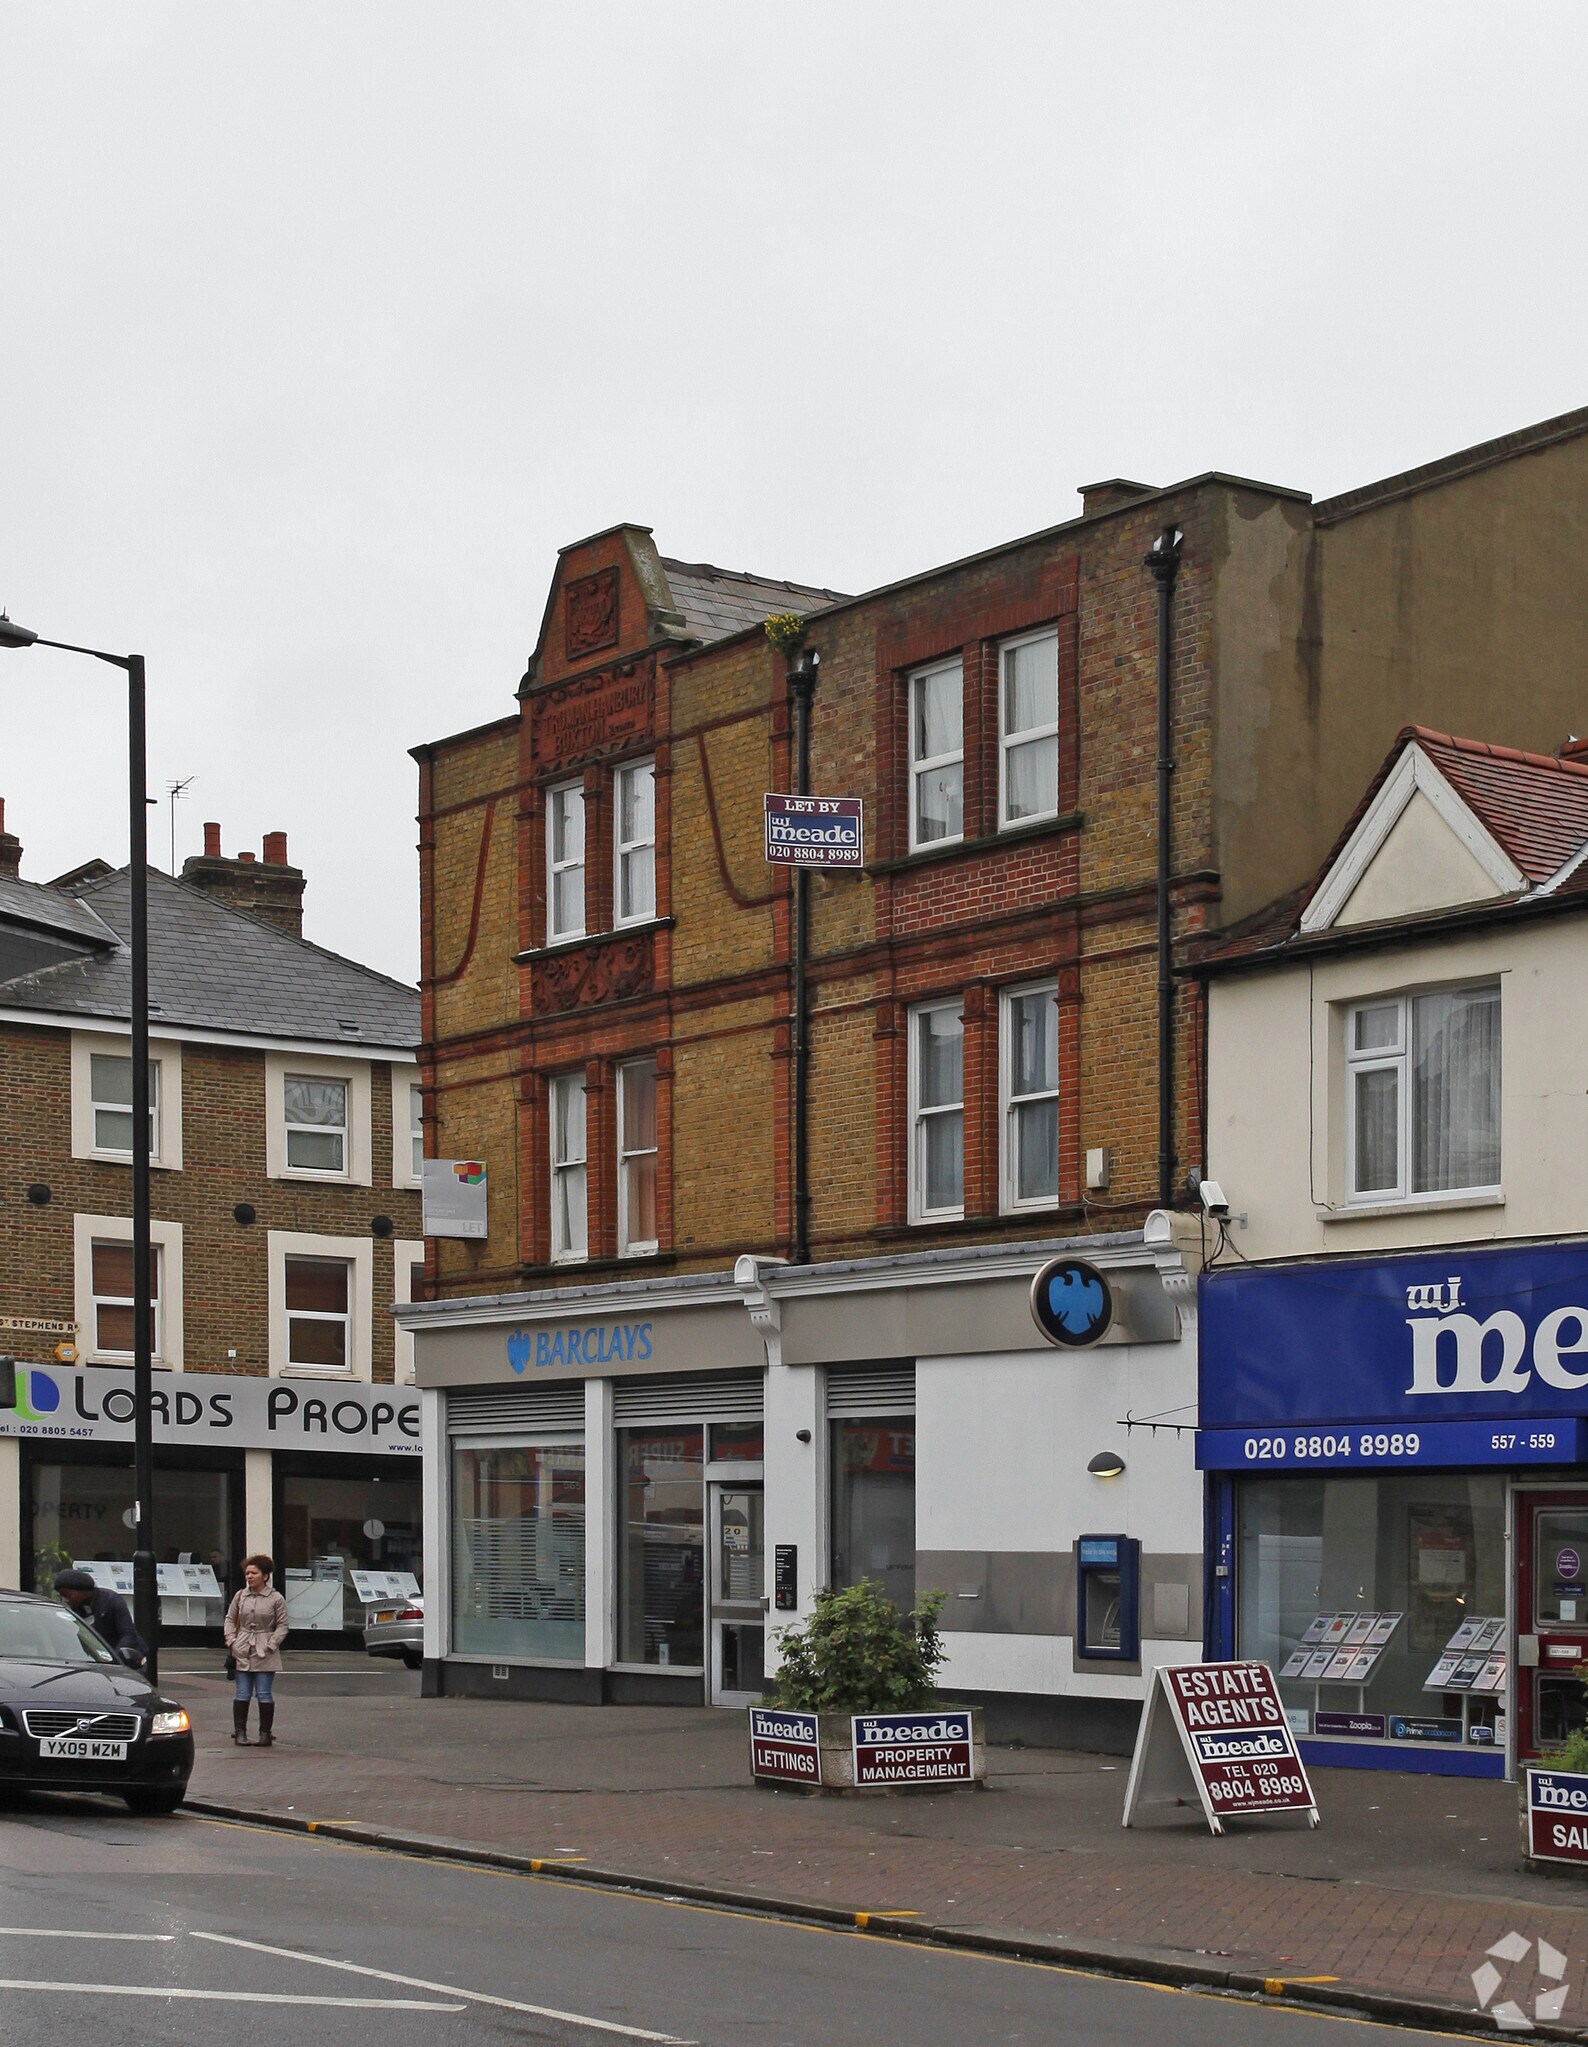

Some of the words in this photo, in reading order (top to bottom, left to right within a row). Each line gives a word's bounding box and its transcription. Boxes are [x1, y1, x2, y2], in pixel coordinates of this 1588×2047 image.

[784, 799, 815, 812] LET
[818, 802, 840, 813] BY
[771, 825, 855, 843] meade
[769, 845, 790, 857] 020
[794, 848, 824, 859] 8804
[828, 849, 859, 860] 8989
[12, 1320, 64, 1331] STEPHENS
[536, 1322, 653, 1367] BARCLAYS
[75, 1375, 233, 1427] LORDS
[268, 1386, 419, 1437] PROPE
[20, 1426, 38, 1434] 020
[42, 1427, 66, 1435] 8805
[70, 1428, 94, 1437] 5457
[1244, 1438, 1286, 1459] 020
[1294, 1436, 1351, 1457] 8804
[1359, 1433, 1420, 1456] 8989
[1491, 1435, 1516, 1449] 557
[1529, 1434, 1555, 1448] 559
[1176, 1668, 1267, 1697] ESTATE
[1187, 1696, 1279, 1726] AGENTS
[756, 1719, 814, 1741] meade
[863, 1721, 964, 1743] meade
[47, 1741, 87, 1755] YX09
[92, 1743, 120, 1757] WZM
[875, 1748, 953, 1763] PROPERTY
[1201, 1735, 1283, 1757] meade
[758, 1749, 815, 1773] LETTINGS
[862, 1763, 966, 1780] MANAGEMENT
[1222, 1765, 1250, 1778] TEL
[1252, 1762, 1278, 1775] 020
[1209, 1779, 1255, 1800] 8804
[1258, 1775, 1303, 1796] 8989
